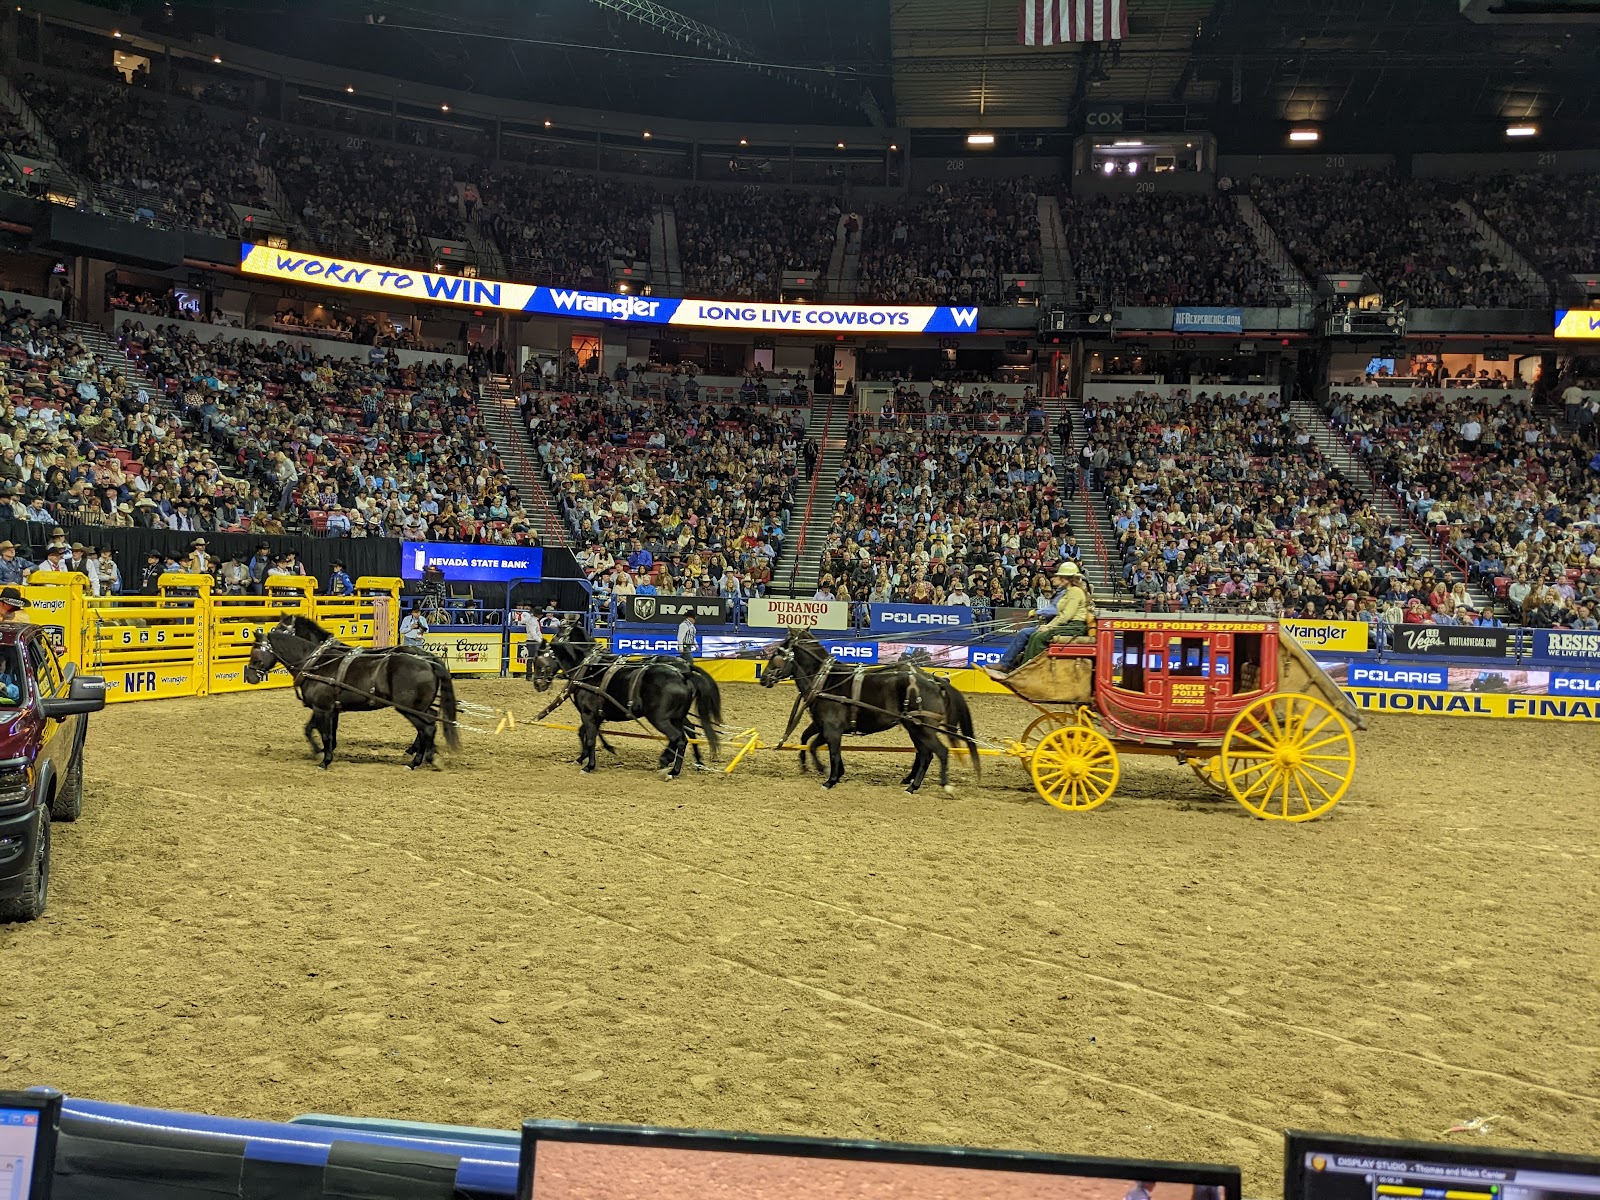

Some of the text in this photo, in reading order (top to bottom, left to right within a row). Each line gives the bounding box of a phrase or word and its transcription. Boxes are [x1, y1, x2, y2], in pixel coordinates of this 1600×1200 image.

[1086, 112, 1123, 126] COX
[946, 159, 964, 171] 208
[1325, 156, 1345, 168] 210
[1538, 153, 1557, 165] 211
[1136, 181, 1155, 193] 209
[277, 255, 501, 306] WORN TO WIN
[550, 288, 660, 320] Wrangler
[698, 306, 909, 326] LONG LIVE COWBOYS
[950, 307, 978, 328] W
[935, 336, 961, 349] 105
[1170, 338, 1197, 350] 106
[1416, 340, 1443, 353] 107
[429, 557, 528, 569] NEVADA STATE BANK
[32, 600, 66, 613] Wrangler
[659, 604, 720, 616] RAM
[767, 601, 829, 614] DURANGO
[776, 613, 819, 626] BOOTS
[881, 612, 961, 625] POLARIS
[242, 627, 249, 639] 6
[340, 624, 369, 635] 7 7
[122, 630, 166, 644] 5 5
[1402, 629, 1446, 652] Vegas
[456, 638, 489, 652] Coors
[124, 671, 188, 693] NFR Wrangler
[215, 672, 240, 682] Wrangler
[1354, 669, 1442, 685] POLARIS
[1171, 683, 1206, 691] SOUTH
[1337, 1157, 1375, 1169] DISPLAY
[1376, 1160, 1407, 1172] STUDIO
